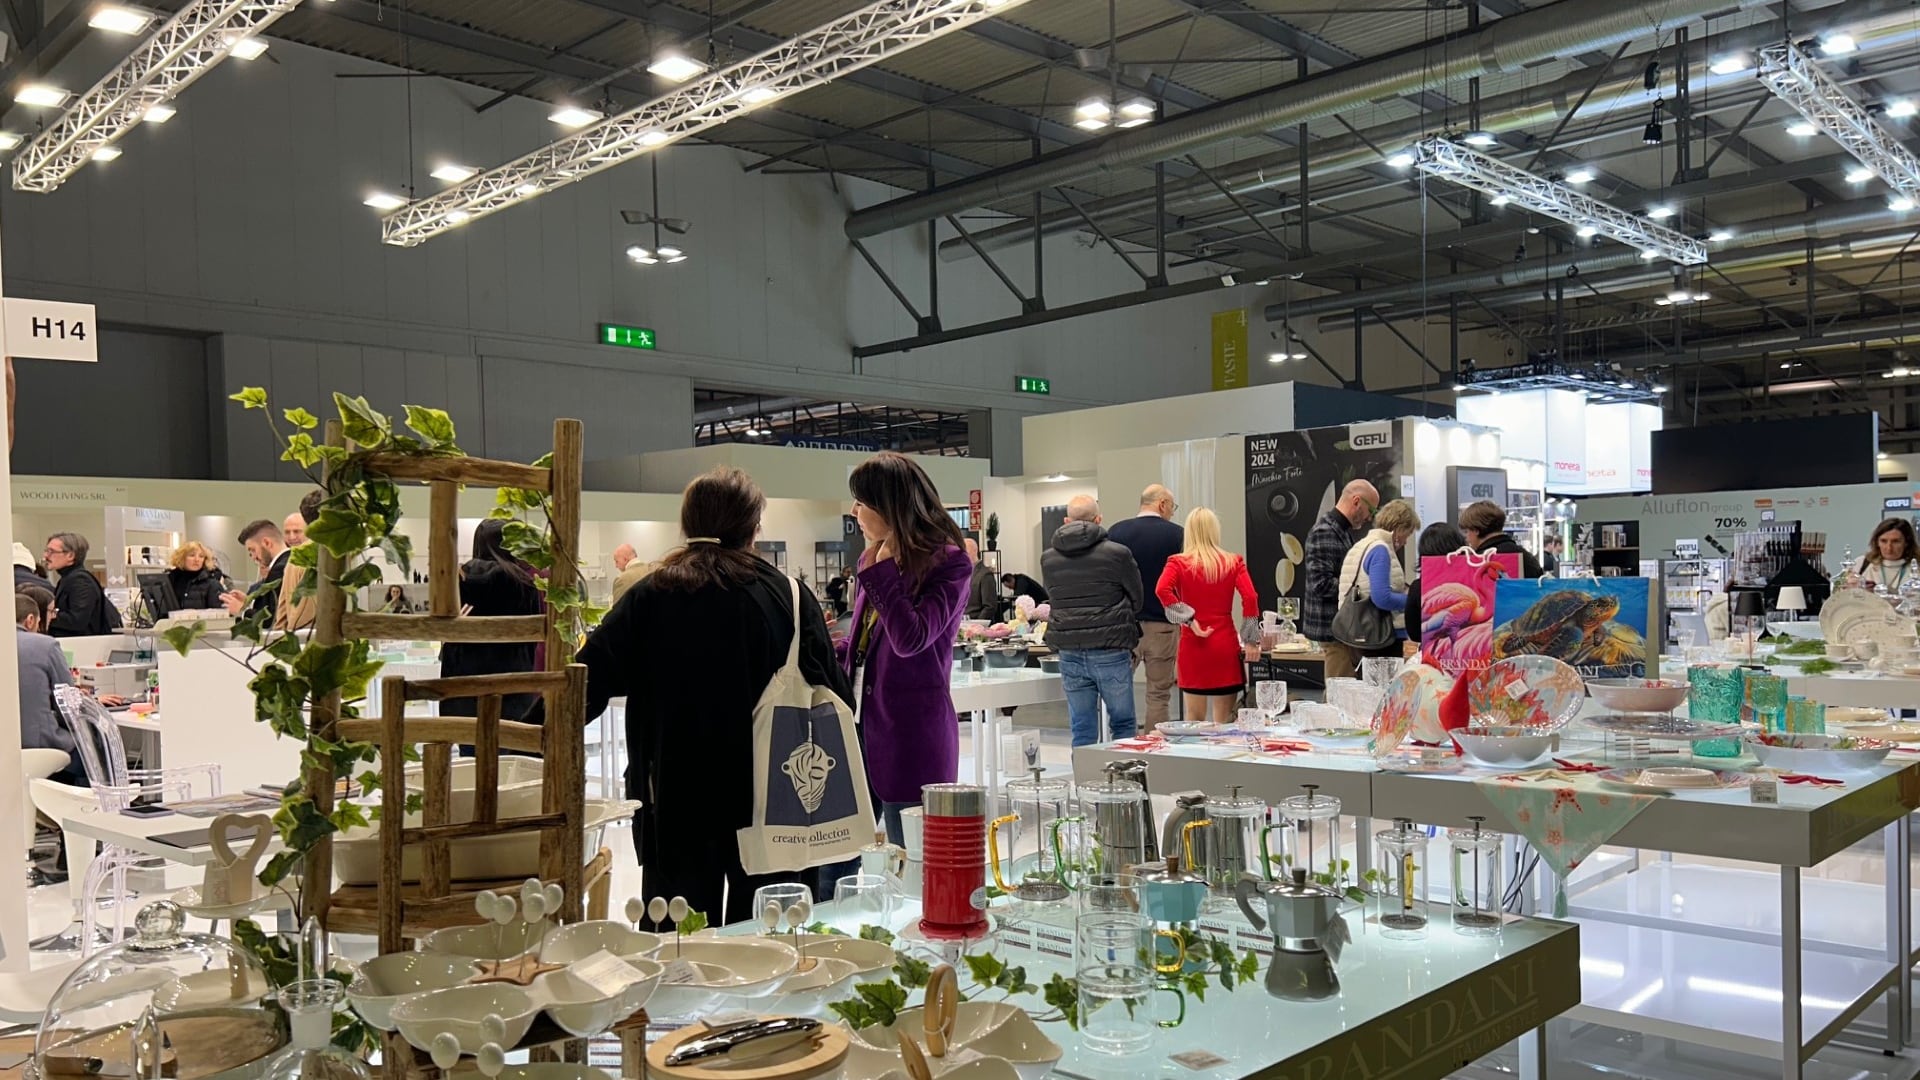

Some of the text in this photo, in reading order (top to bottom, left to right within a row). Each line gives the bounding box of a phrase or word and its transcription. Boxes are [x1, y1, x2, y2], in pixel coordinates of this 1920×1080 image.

[32, 316, 86, 341] H14
[1250, 438, 1278, 452] NEW
[1353, 432, 1388, 446] GEFU
[1250, 453, 1276, 467] 2024
[19, 490, 107, 501] WOOD LIVING SRL
[1471, 483, 1494, 498] GEFU
[1641, 499, 1710, 515] Alluflon
[1714, 517, 1748, 528] 70%
[1440, 658, 1492, 670] BRANDA
[1270, 957, 1539, 1080] RANDANI
